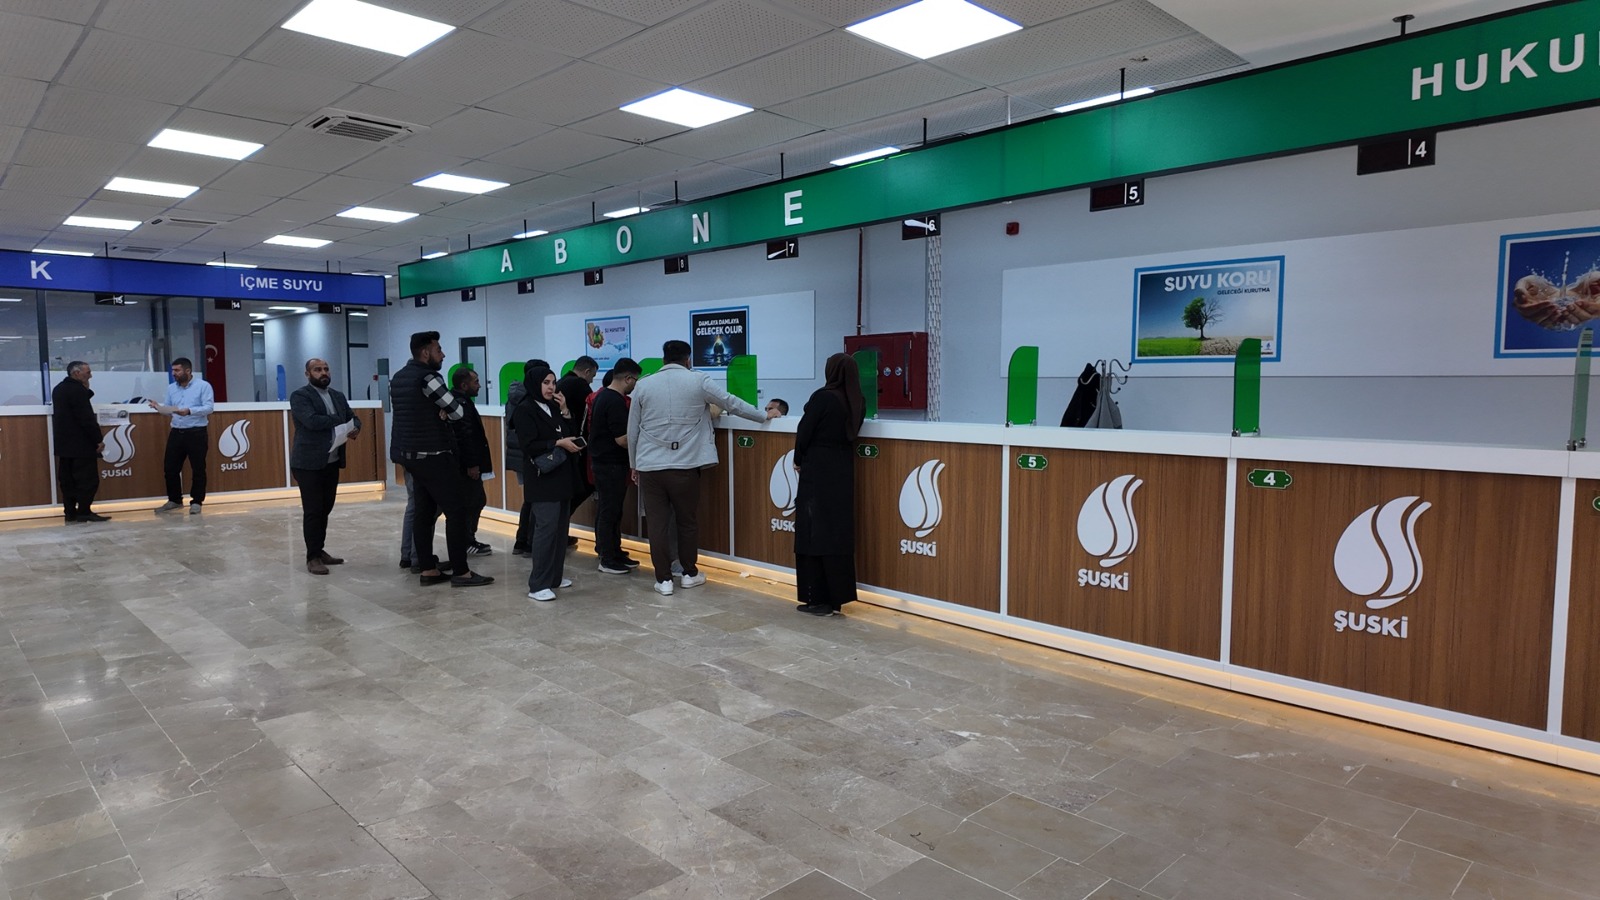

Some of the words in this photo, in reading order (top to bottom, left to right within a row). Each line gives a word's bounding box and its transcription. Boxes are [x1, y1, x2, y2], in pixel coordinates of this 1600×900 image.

[1412, 30, 1600, 100] HUKU
[1415, 141, 1427, 158] 4
[1129, 186, 1138, 200] 5
[501, 190, 803, 272] ABONE
[929, 220, 936, 231] 6
[789, 243, 795, 254] 7
[30, 260, 53, 280] K
[240, 273, 278, 291] İÇME
[283, 279, 323, 292] SUYU
[1164, 274, 1212, 292] SUYU
[1217, 269, 1272, 288] KORU
[1217, 288, 1243, 296] GELECEĞİ
[698, 319, 718, 327] DAMLAYA
[696, 326, 724, 336] GELECEK
[725, 325, 743, 334] OLUR
[743, 438, 748, 446] 7
[864, 446, 870, 456] 6
[221, 461, 248, 472] ŞUSKİ
[1028, 456, 1037, 468] 5
[101, 467, 132, 479] ŞUSKİ
[1263, 472, 1276, 486] 4
[771, 518, 795, 532] ŞUSK
[900, 539, 937, 557] ŞUSKİ
[1077, 568, 1129, 591] ŞUSKİ
[1333, 610, 1408, 639] ŞUSKİ
